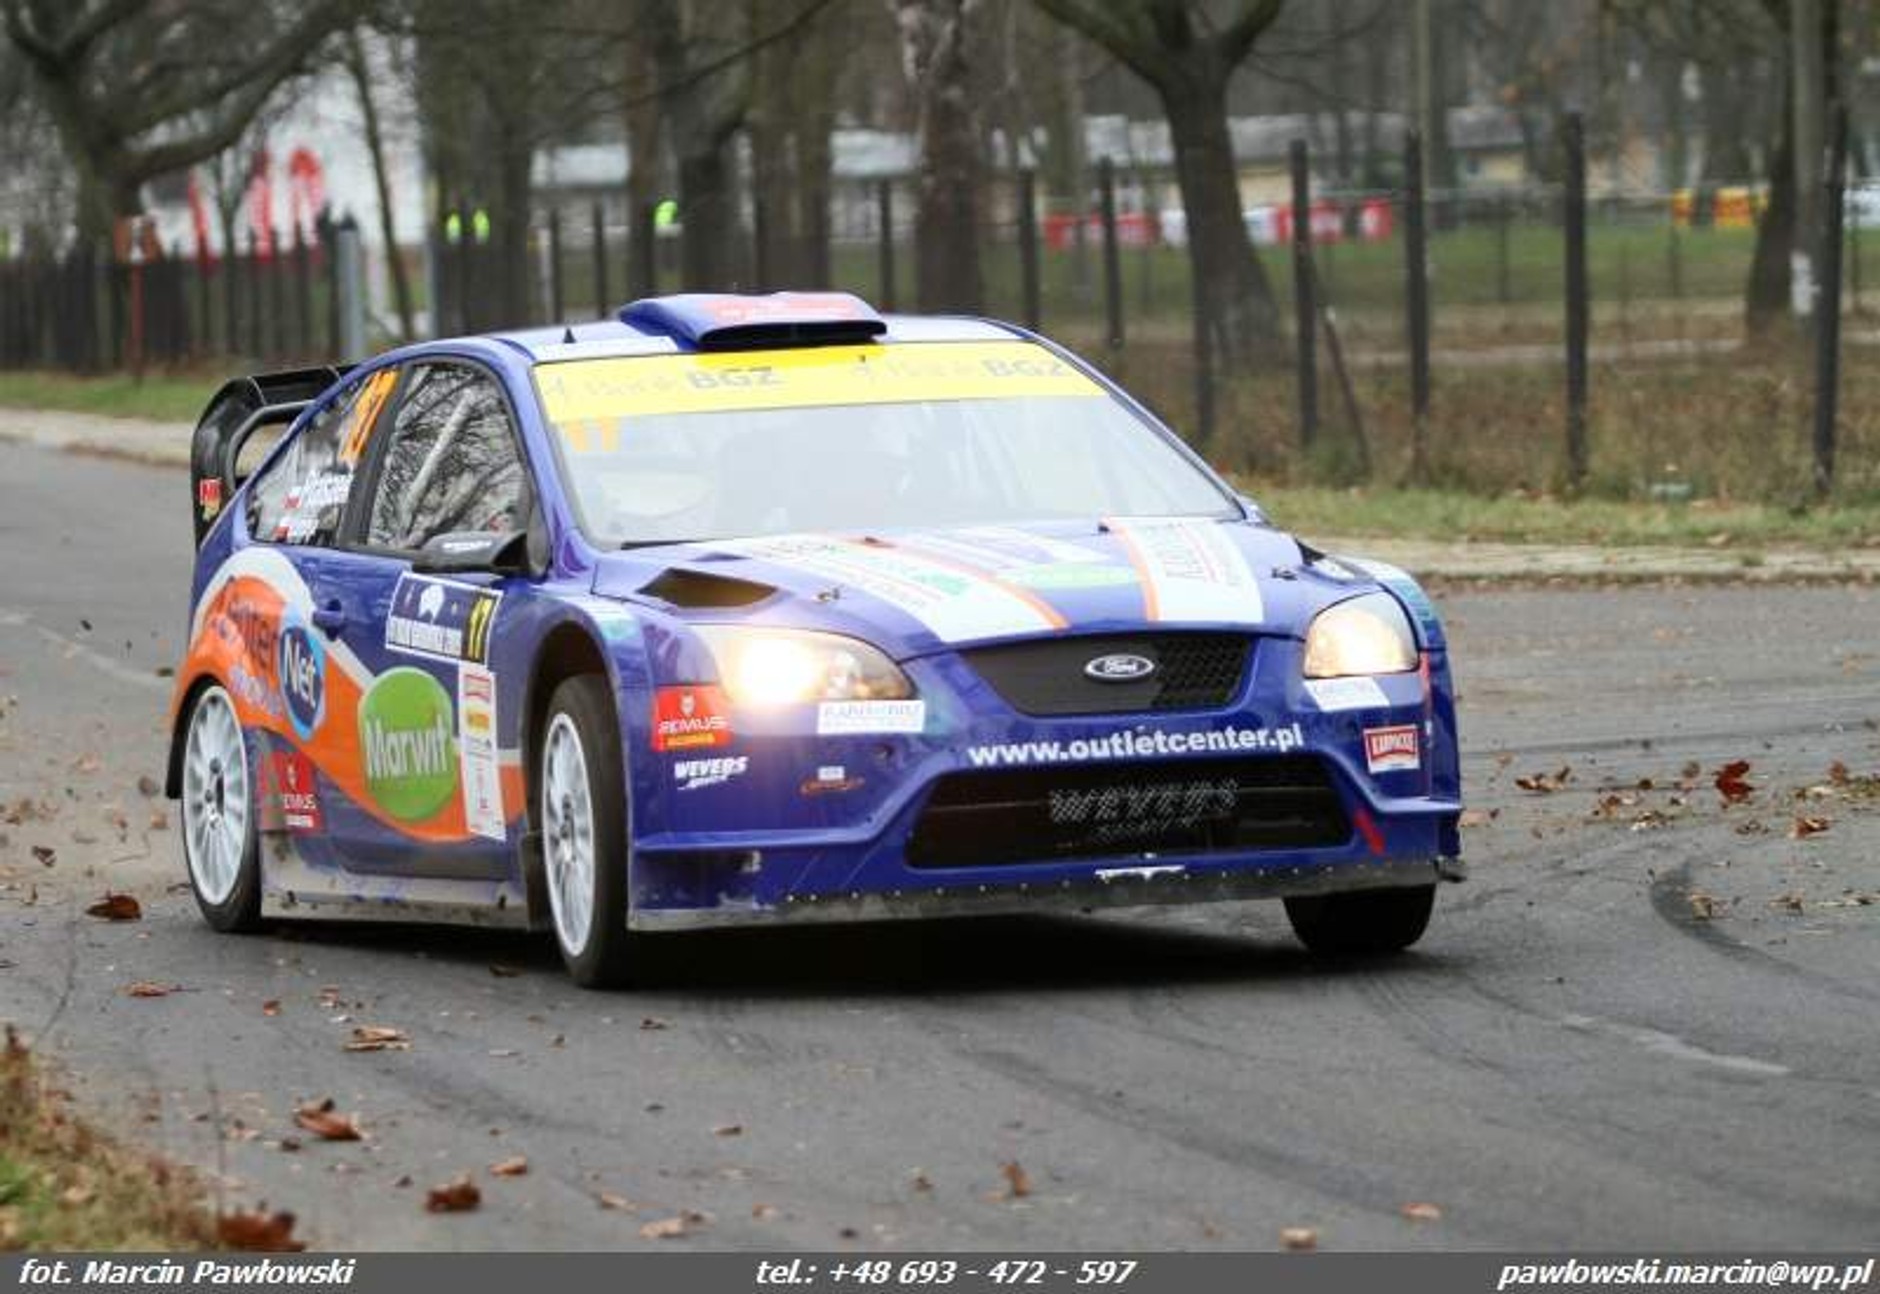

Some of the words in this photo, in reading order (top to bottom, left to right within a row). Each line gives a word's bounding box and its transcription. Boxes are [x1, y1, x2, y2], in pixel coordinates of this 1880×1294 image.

[467, 596, 493, 661] 17
[283, 632, 317, 710] Net
[1104, 658, 1137, 674] Ford
[365, 713, 448, 779] Marwit
[674, 756, 750, 780] WEVERS
[968, 723, 1304, 767] www.outletcenter.pl
